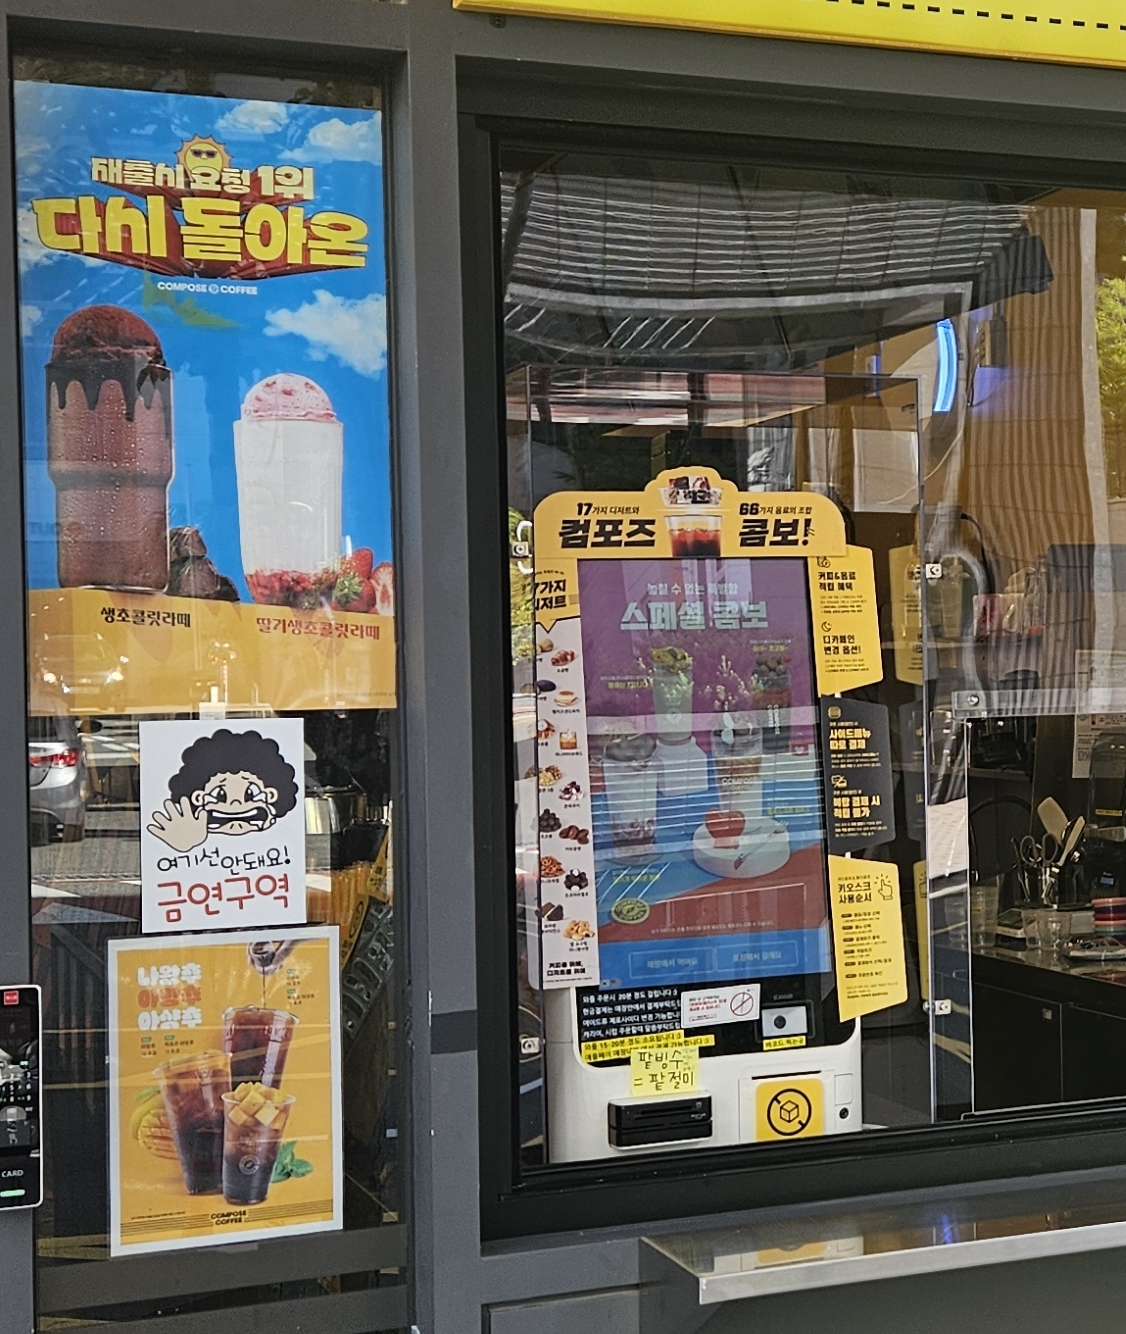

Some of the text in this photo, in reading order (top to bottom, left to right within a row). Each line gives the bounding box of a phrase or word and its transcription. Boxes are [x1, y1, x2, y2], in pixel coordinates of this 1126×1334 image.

[190, 166, 251, 195] 요청
[257, 165, 315, 201] 1위
[31, 195, 370, 267] 다시 돌아온
[157, 281, 258, 296] COMPOSE COFFEE
[576, 503, 608, 517] 17가지
[739, 502, 774, 516] 66가지
[558, 519, 657, 549] 컴포즈
[738, 518, 813, 548] 콤보!
[100, 606, 191, 628] 생초콜릿라떼
[620, 601, 706, 630] 스페셜
[256, 617, 380, 641] 딸기생초콜릿라떼
[157, 845, 291, 875] 여기선 안돼요!
[838, 881, 872, 893] 키오스크
[157, 873, 289, 923] 금연구역
[838, 892, 872, 904] 사용순서
[637, 1050, 684, 1071] 팥빙수
[649, 1071, 694, 1091] 팥절미
[1, 1169, 25, 1178] CARD
[210, 1210, 247, 1221] COMPOSE
[215, 1218, 243, 1226] COFFEE
